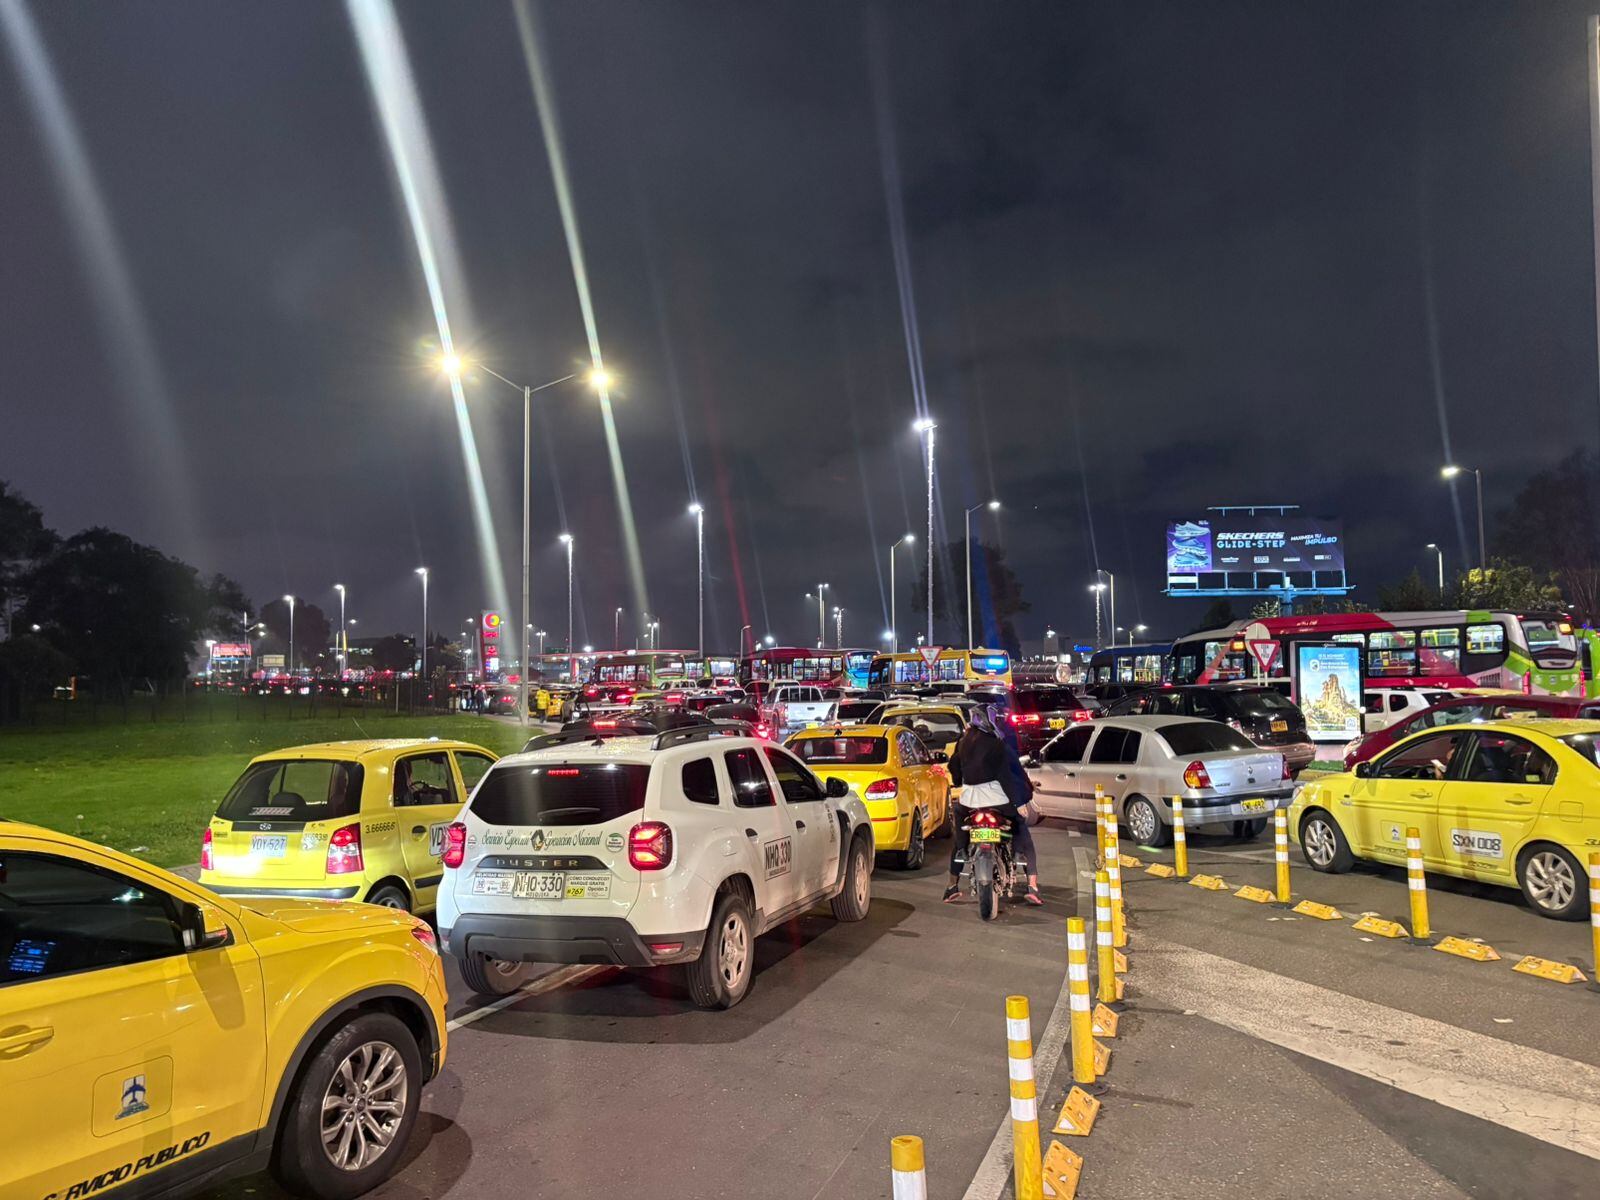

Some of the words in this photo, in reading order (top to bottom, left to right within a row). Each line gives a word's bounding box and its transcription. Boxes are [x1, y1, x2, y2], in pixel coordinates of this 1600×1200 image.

[1216, 532, 1285, 540] SKECHERS
[1216, 540, 1286, 549] GLIDE-STEP
[1305, 536, 1337, 546] IMPULSO
[1452, 834, 1475, 849] SXN
[1477, 837, 1501, 852] 008
[496, 859, 580, 868] DUSTER
[132, 1131, 211, 1175] PUBLICO
